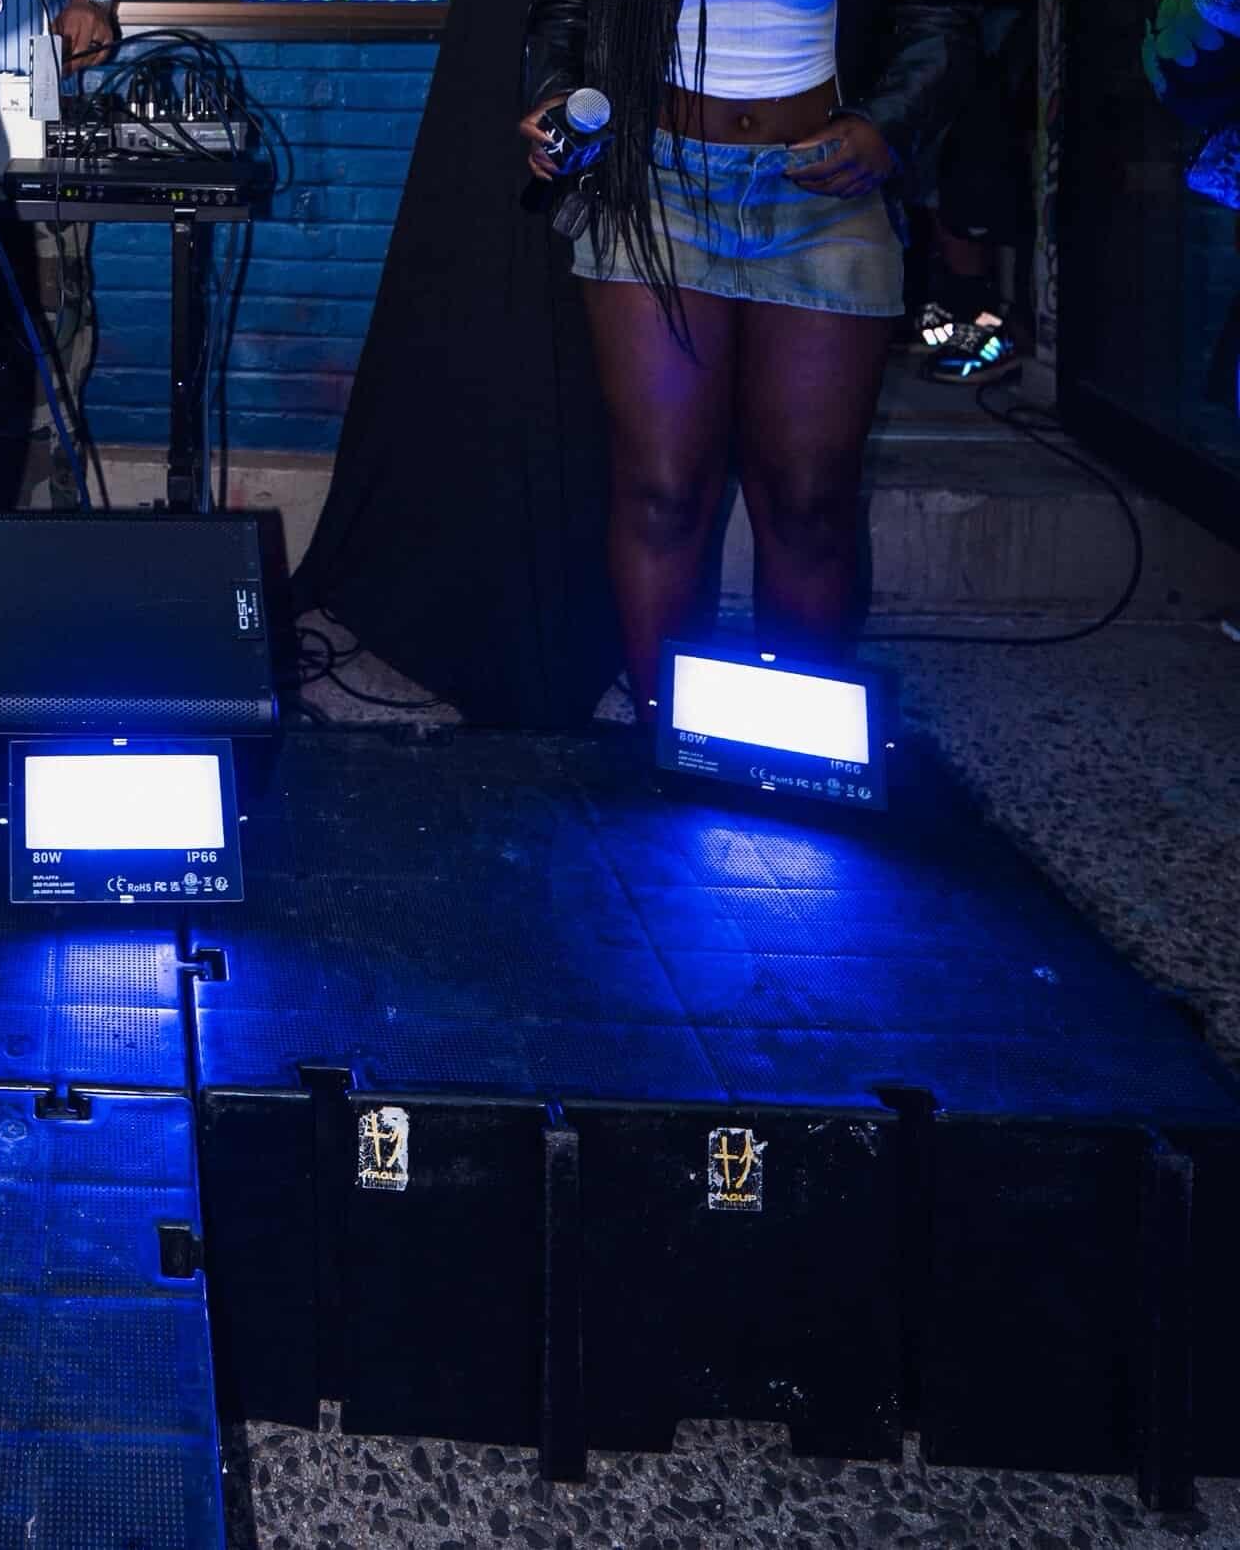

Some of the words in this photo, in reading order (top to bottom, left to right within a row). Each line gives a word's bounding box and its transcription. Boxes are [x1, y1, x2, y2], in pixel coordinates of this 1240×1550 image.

[236, 589, 249, 630] QSC
[32, 852, 62, 863] 80W
[187, 851, 217, 863] IP66
[127, 882, 152, 892] RoHS
